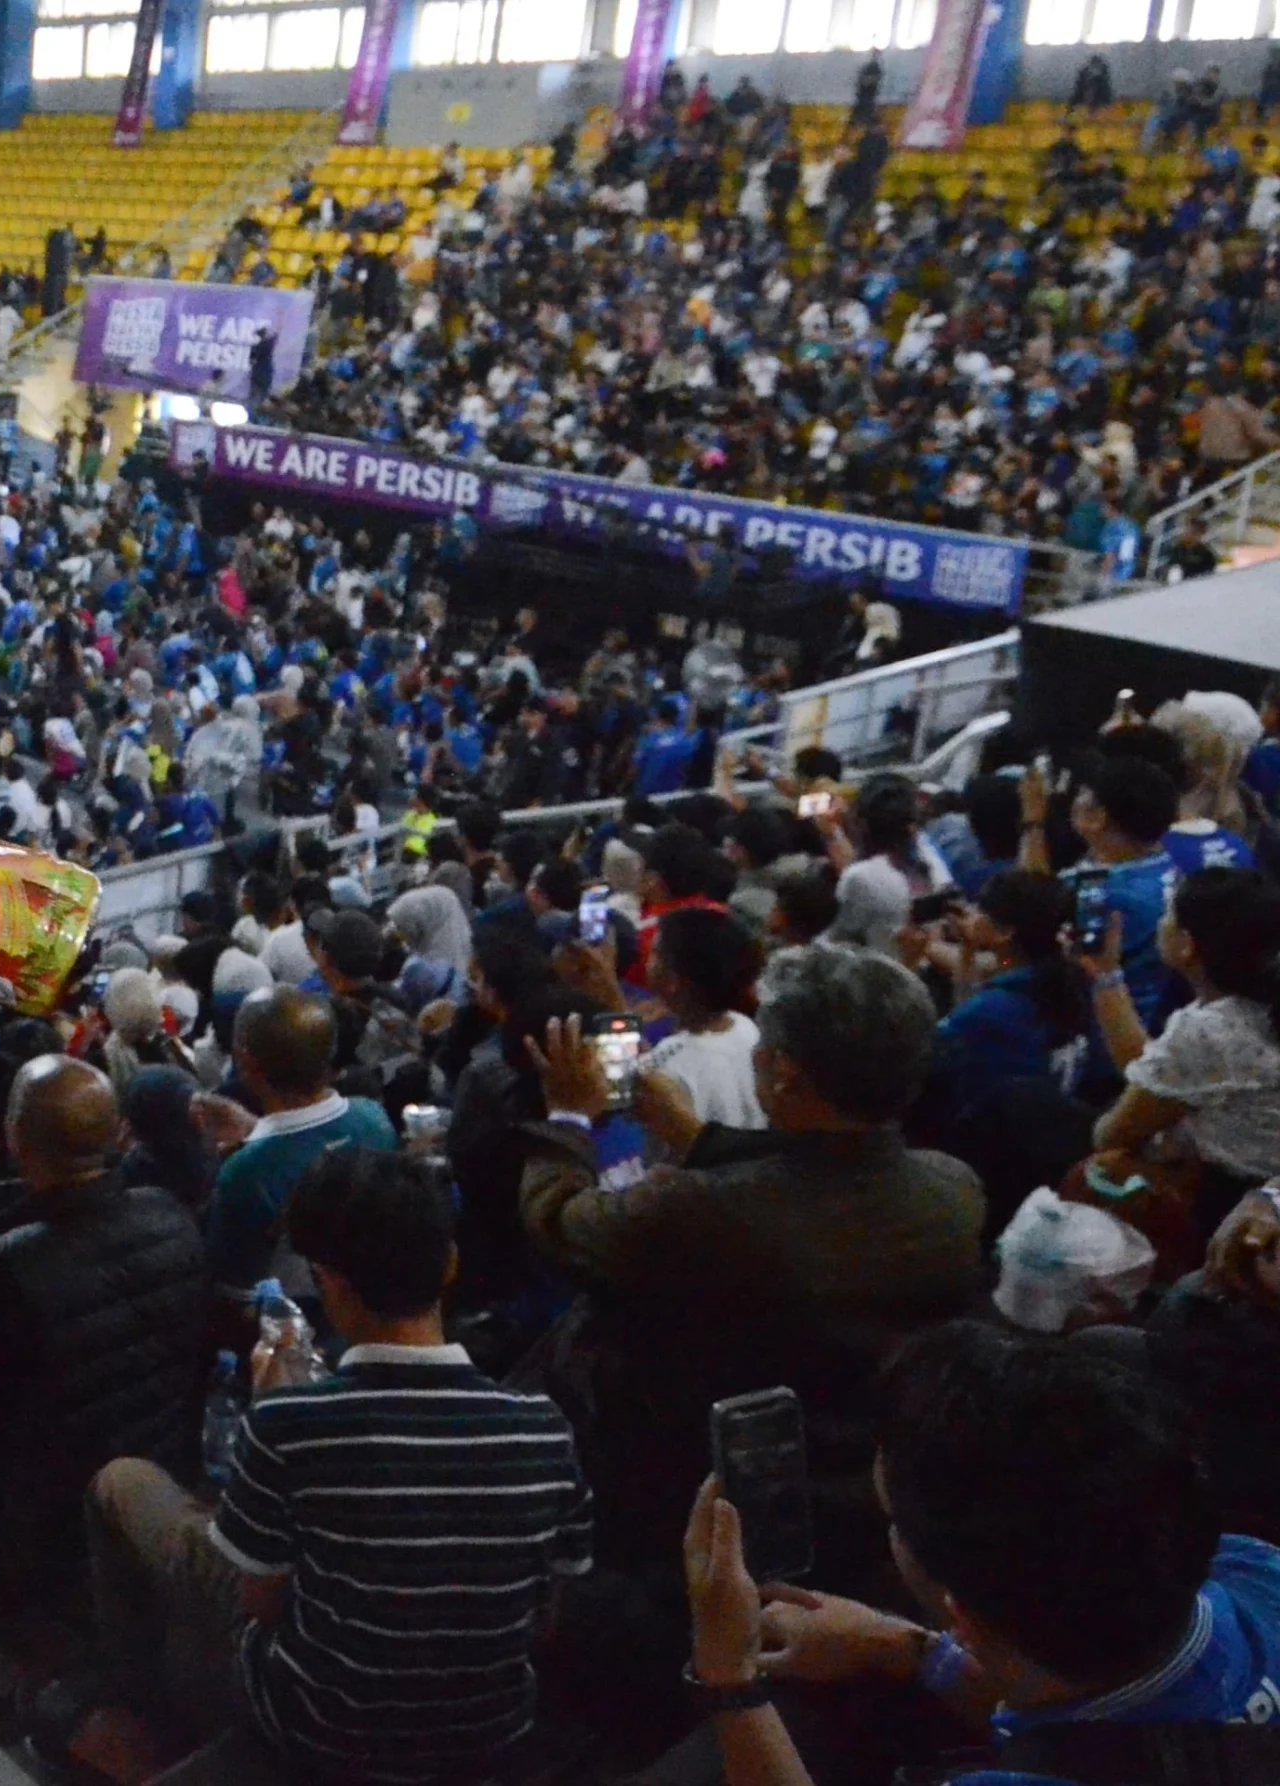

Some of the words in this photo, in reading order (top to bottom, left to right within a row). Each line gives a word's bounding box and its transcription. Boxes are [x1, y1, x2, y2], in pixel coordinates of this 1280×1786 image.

[178, 313, 217, 338] WE
[224, 434, 274, 472] WE
[279, 444, 349, 486] ARE
[354, 454, 481, 507] PERSIB
[743, 516, 923, 582] PERSIB
